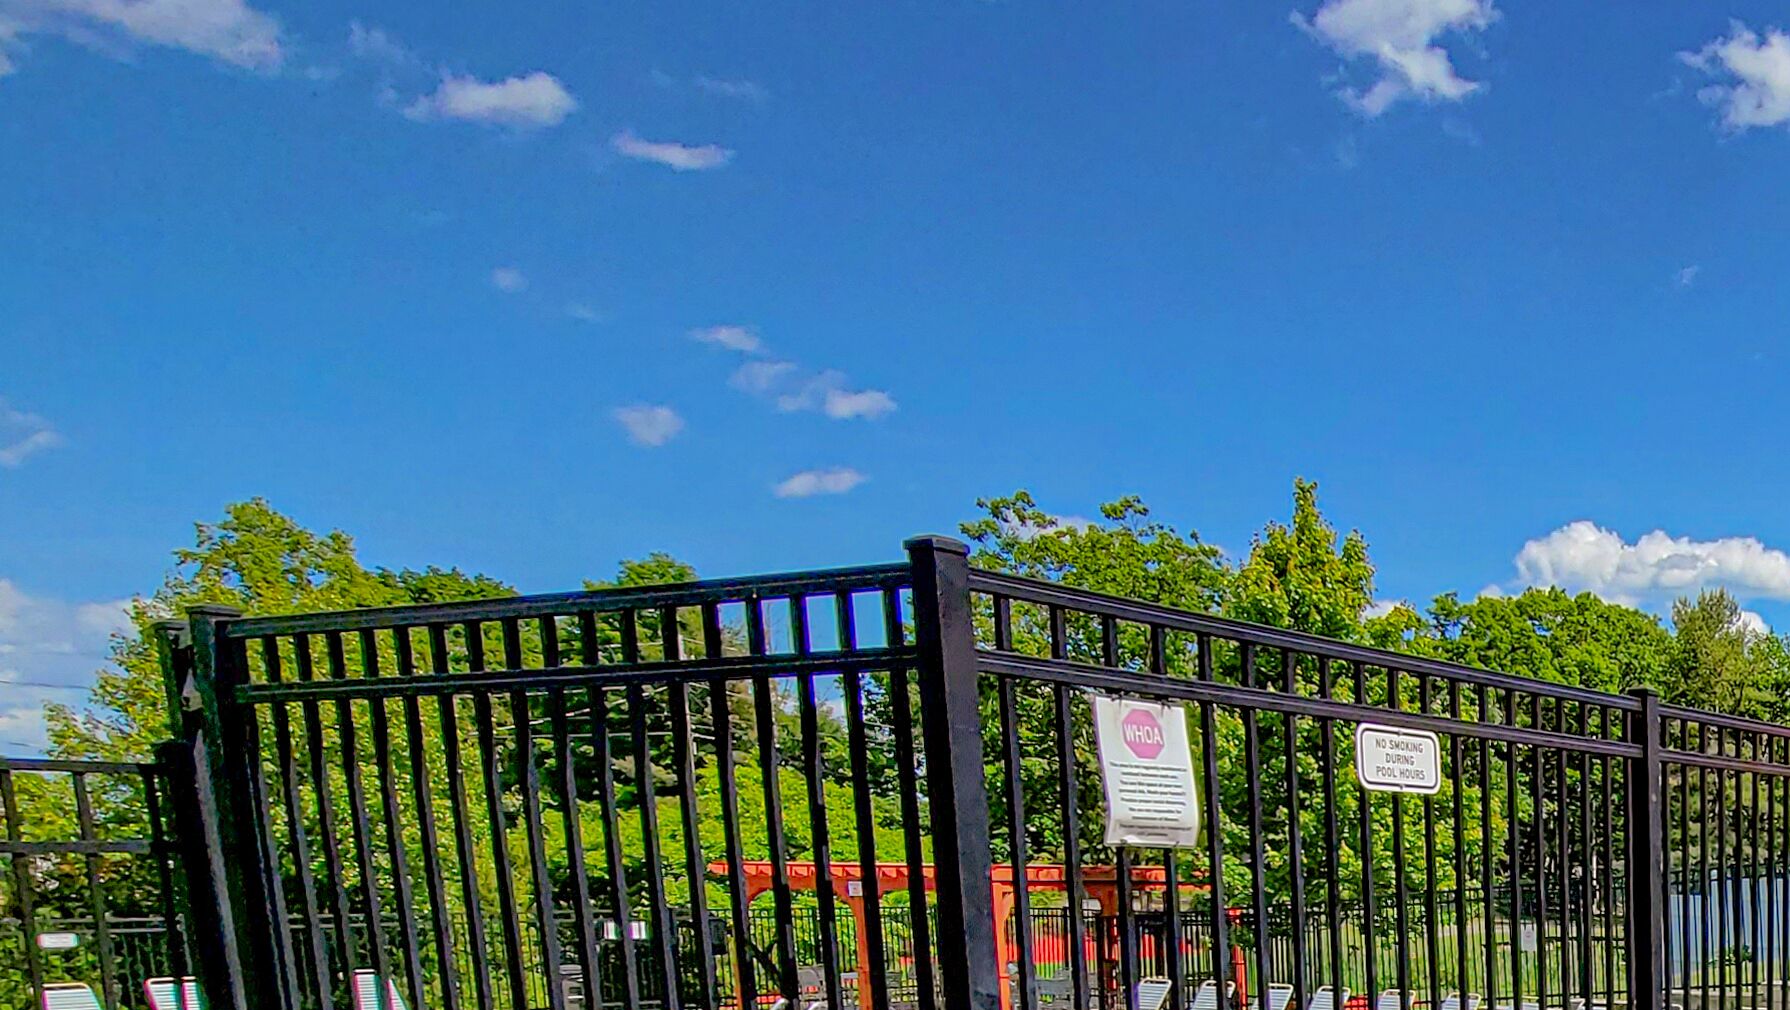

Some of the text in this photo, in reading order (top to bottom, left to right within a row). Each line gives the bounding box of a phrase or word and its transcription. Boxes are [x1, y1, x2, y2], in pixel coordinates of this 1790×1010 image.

[1124, 724, 1163, 744] WHOA
[1375, 738, 1424, 753] NO SMOKING
[1385, 754, 1415, 766] DURING
[1376, 766, 1425, 780] POOL HOURS
